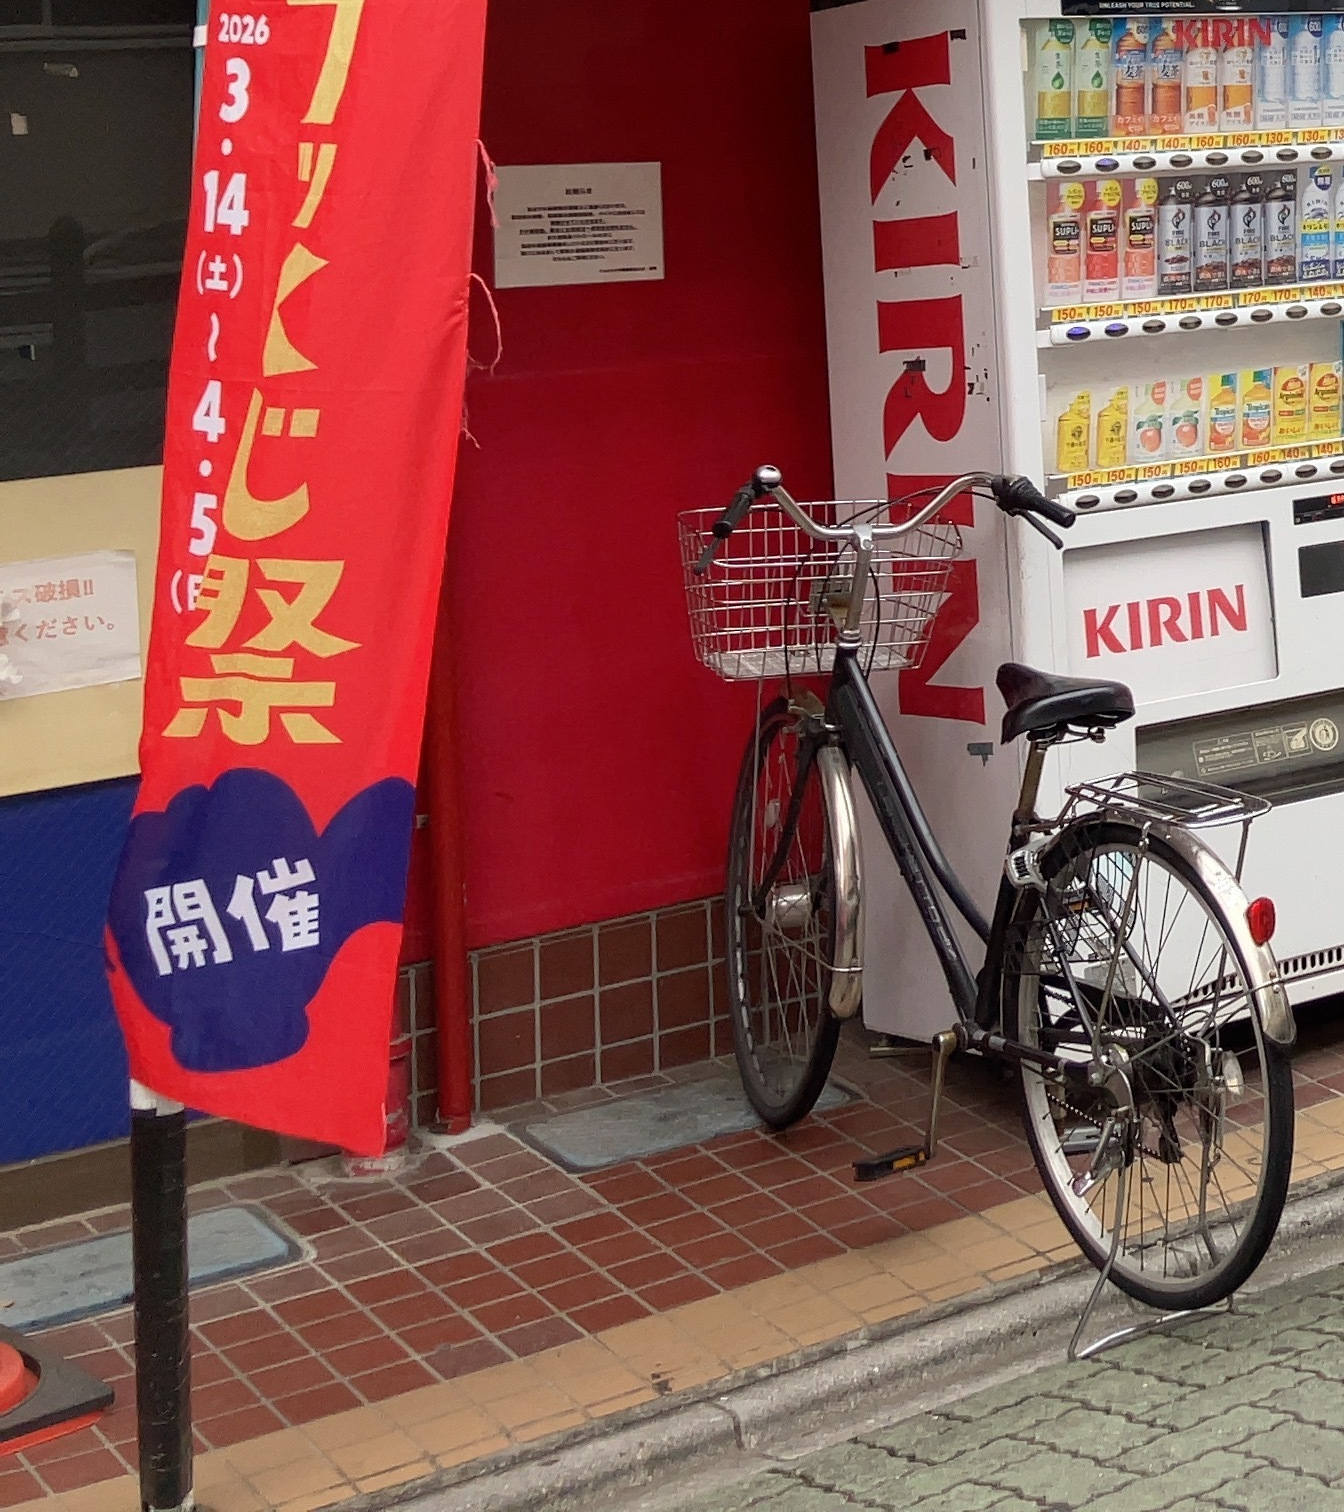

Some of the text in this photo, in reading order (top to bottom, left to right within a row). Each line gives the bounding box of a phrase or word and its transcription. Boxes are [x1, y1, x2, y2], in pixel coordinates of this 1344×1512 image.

[219, 13, 270, 45] 2026
[1174, 17, 1272, 48] KIRIN
[864, 29, 987, 727] KIRIN
[1083, 584, 1248, 659] KIRIN
[144, 857, 320, 976] 開催
